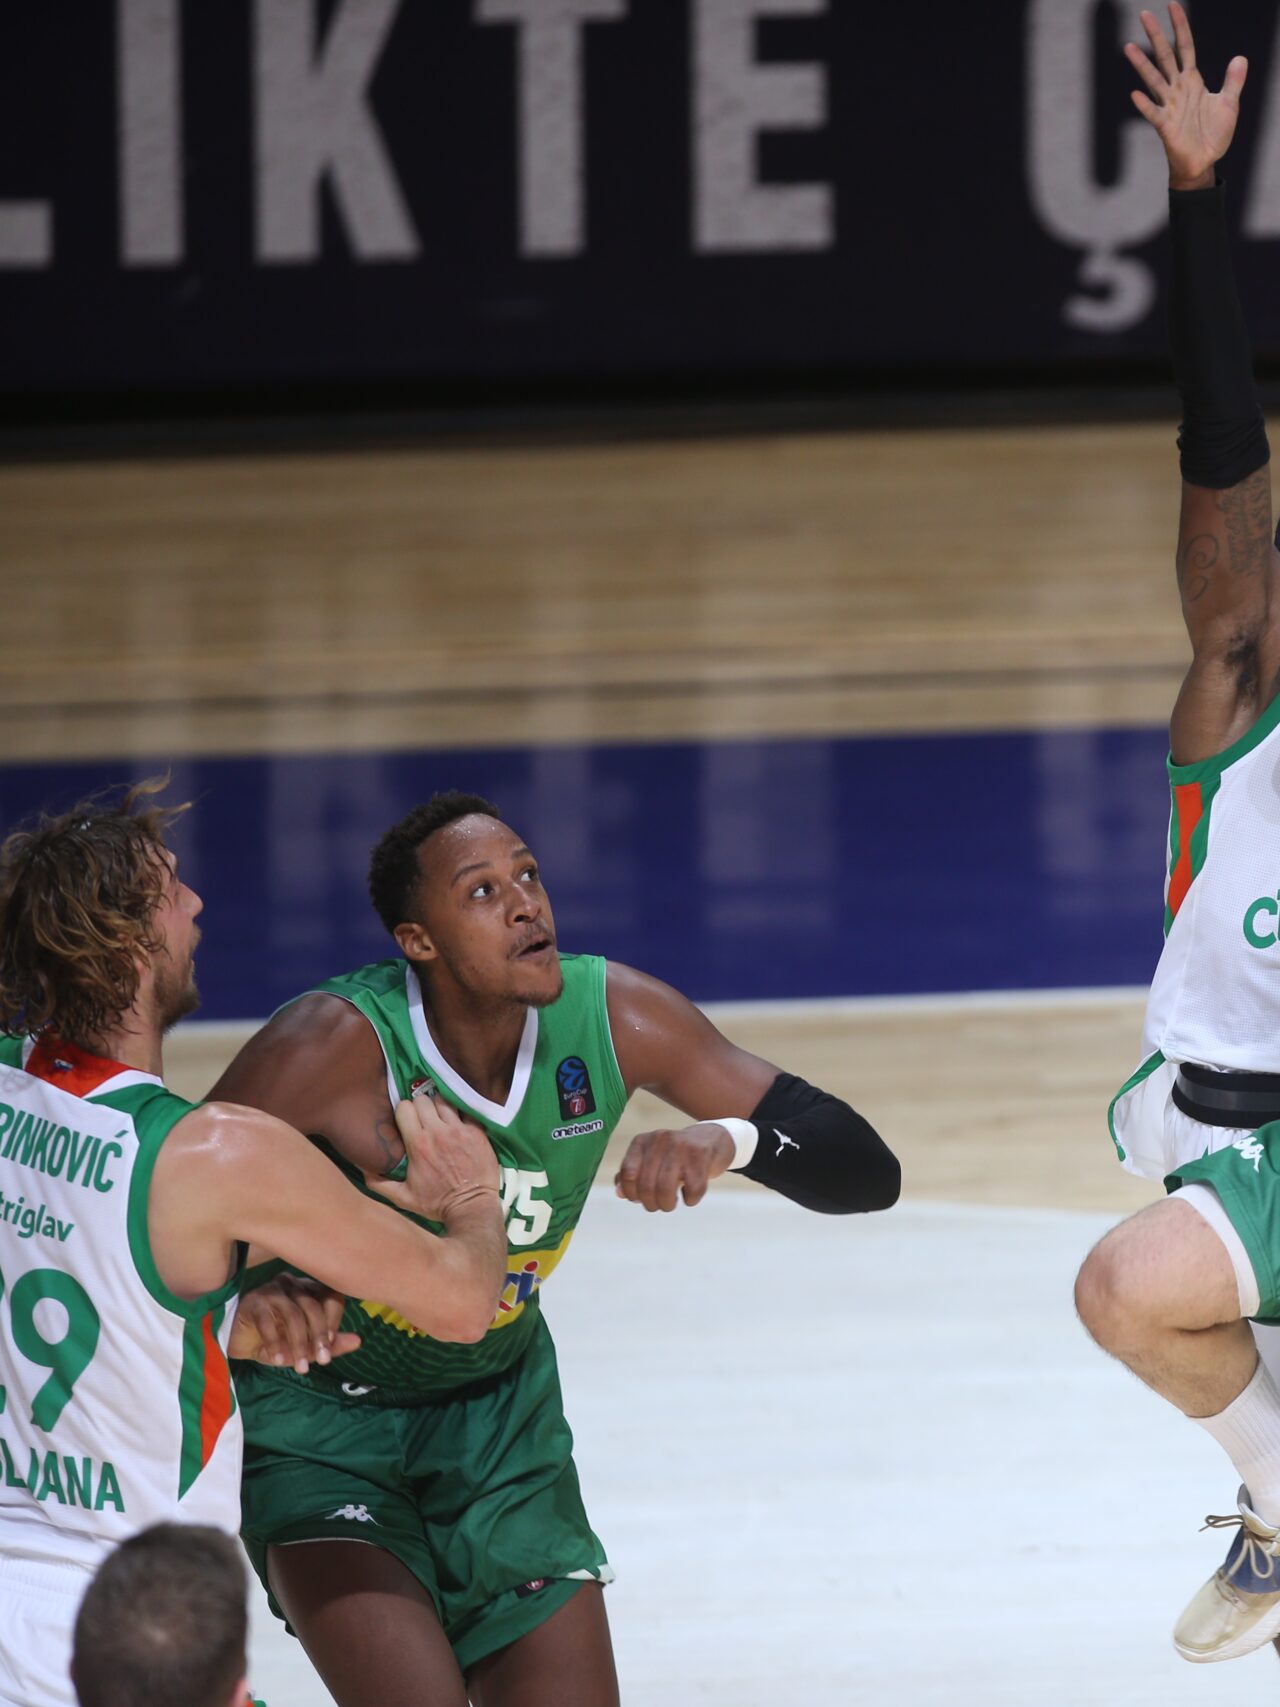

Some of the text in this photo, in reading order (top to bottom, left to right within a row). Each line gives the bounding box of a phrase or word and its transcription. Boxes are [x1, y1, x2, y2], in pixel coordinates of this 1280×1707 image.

[0, 0, 834, 269] IKTE
[0, 1264, 102, 1433] 9
[0, 1438, 126, 1513] LJANA
